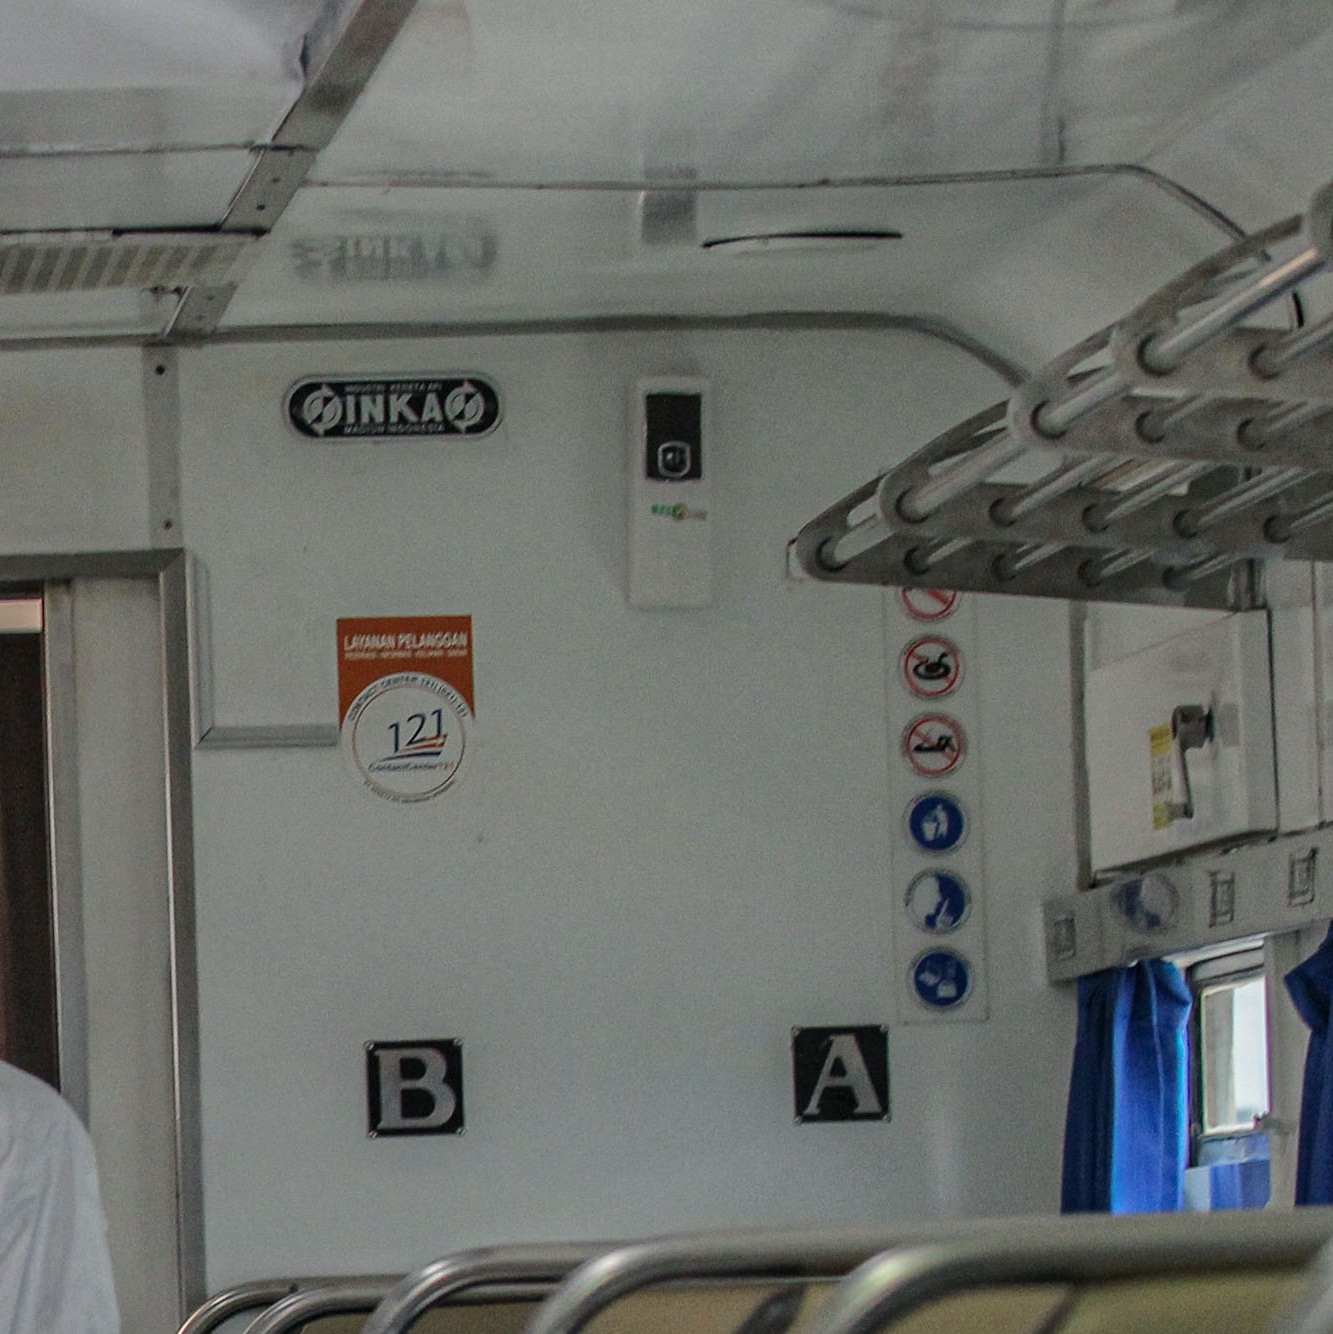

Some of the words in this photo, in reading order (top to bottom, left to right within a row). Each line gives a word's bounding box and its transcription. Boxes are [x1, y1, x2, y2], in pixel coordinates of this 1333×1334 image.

[345, 393, 444, 424] INKA
[344, 634, 396, 650] LAYANAN
[398, 631, 468, 649] PELANGGAN
[388, 708, 443, 753] 121
[376, 1049, 456, 1130] B
[805, 1035, 879, 1116] A
